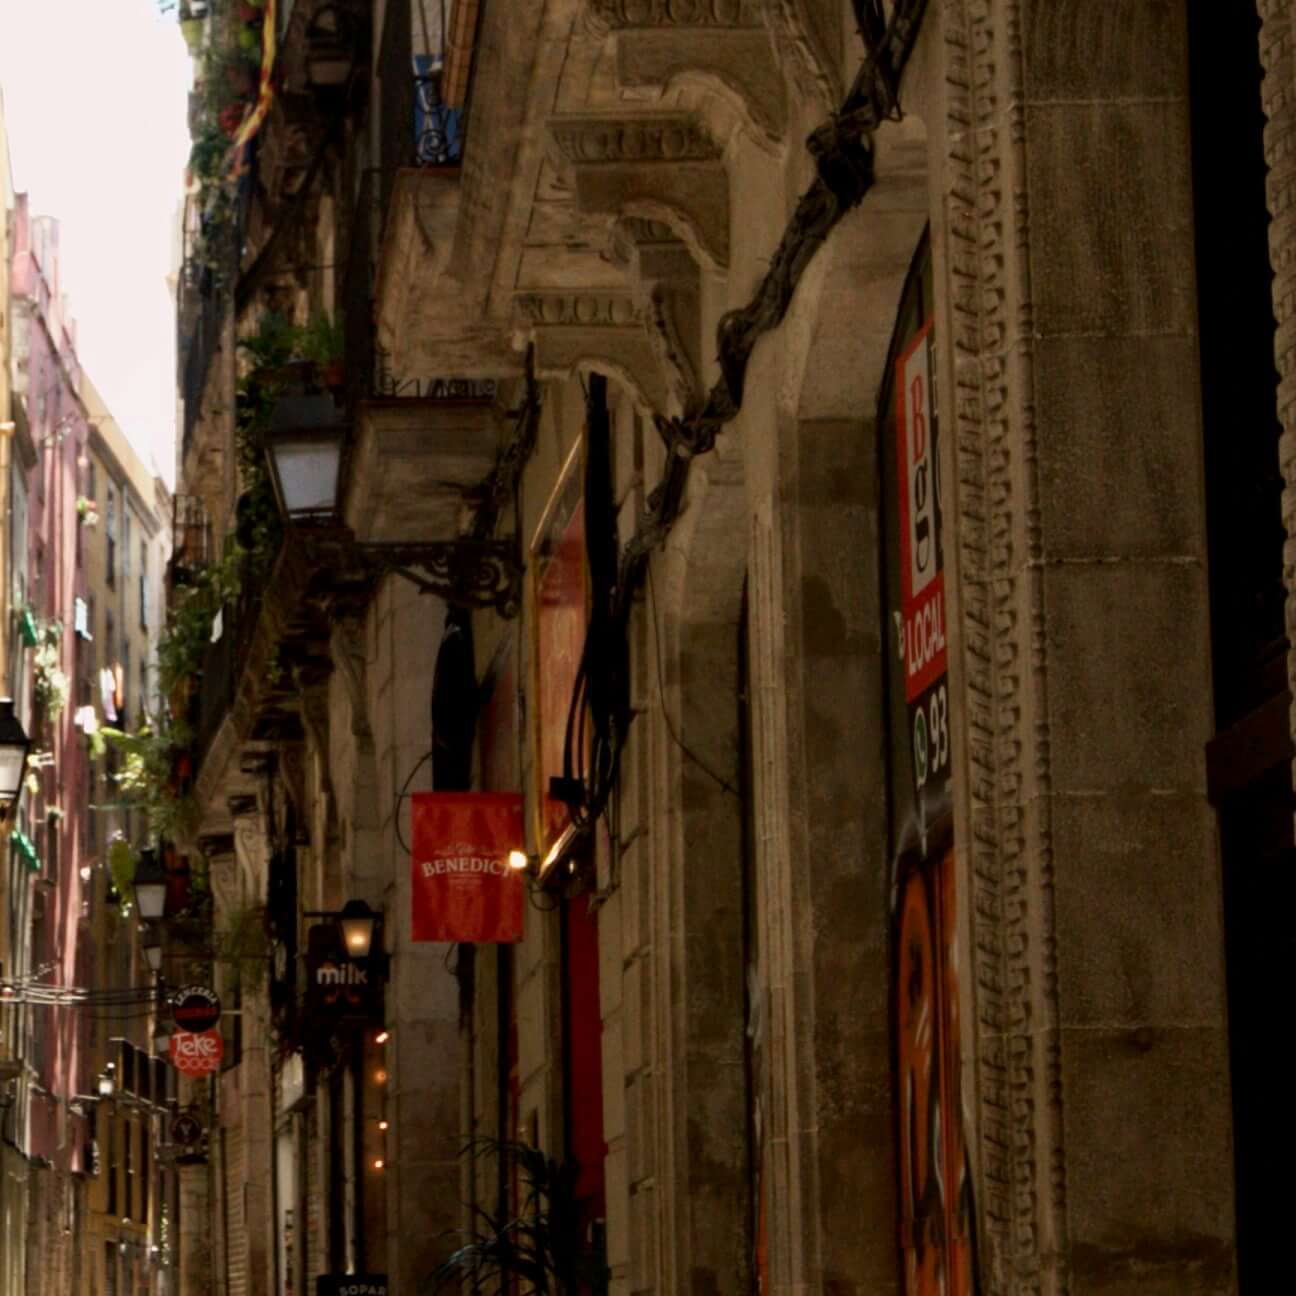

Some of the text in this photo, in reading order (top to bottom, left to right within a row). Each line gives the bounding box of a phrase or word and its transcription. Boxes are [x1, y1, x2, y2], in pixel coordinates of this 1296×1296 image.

[906, 592, 945, 677] LOCAL
[930, 685, 948, 774] 93
[316, 962, 369, 985] milk
